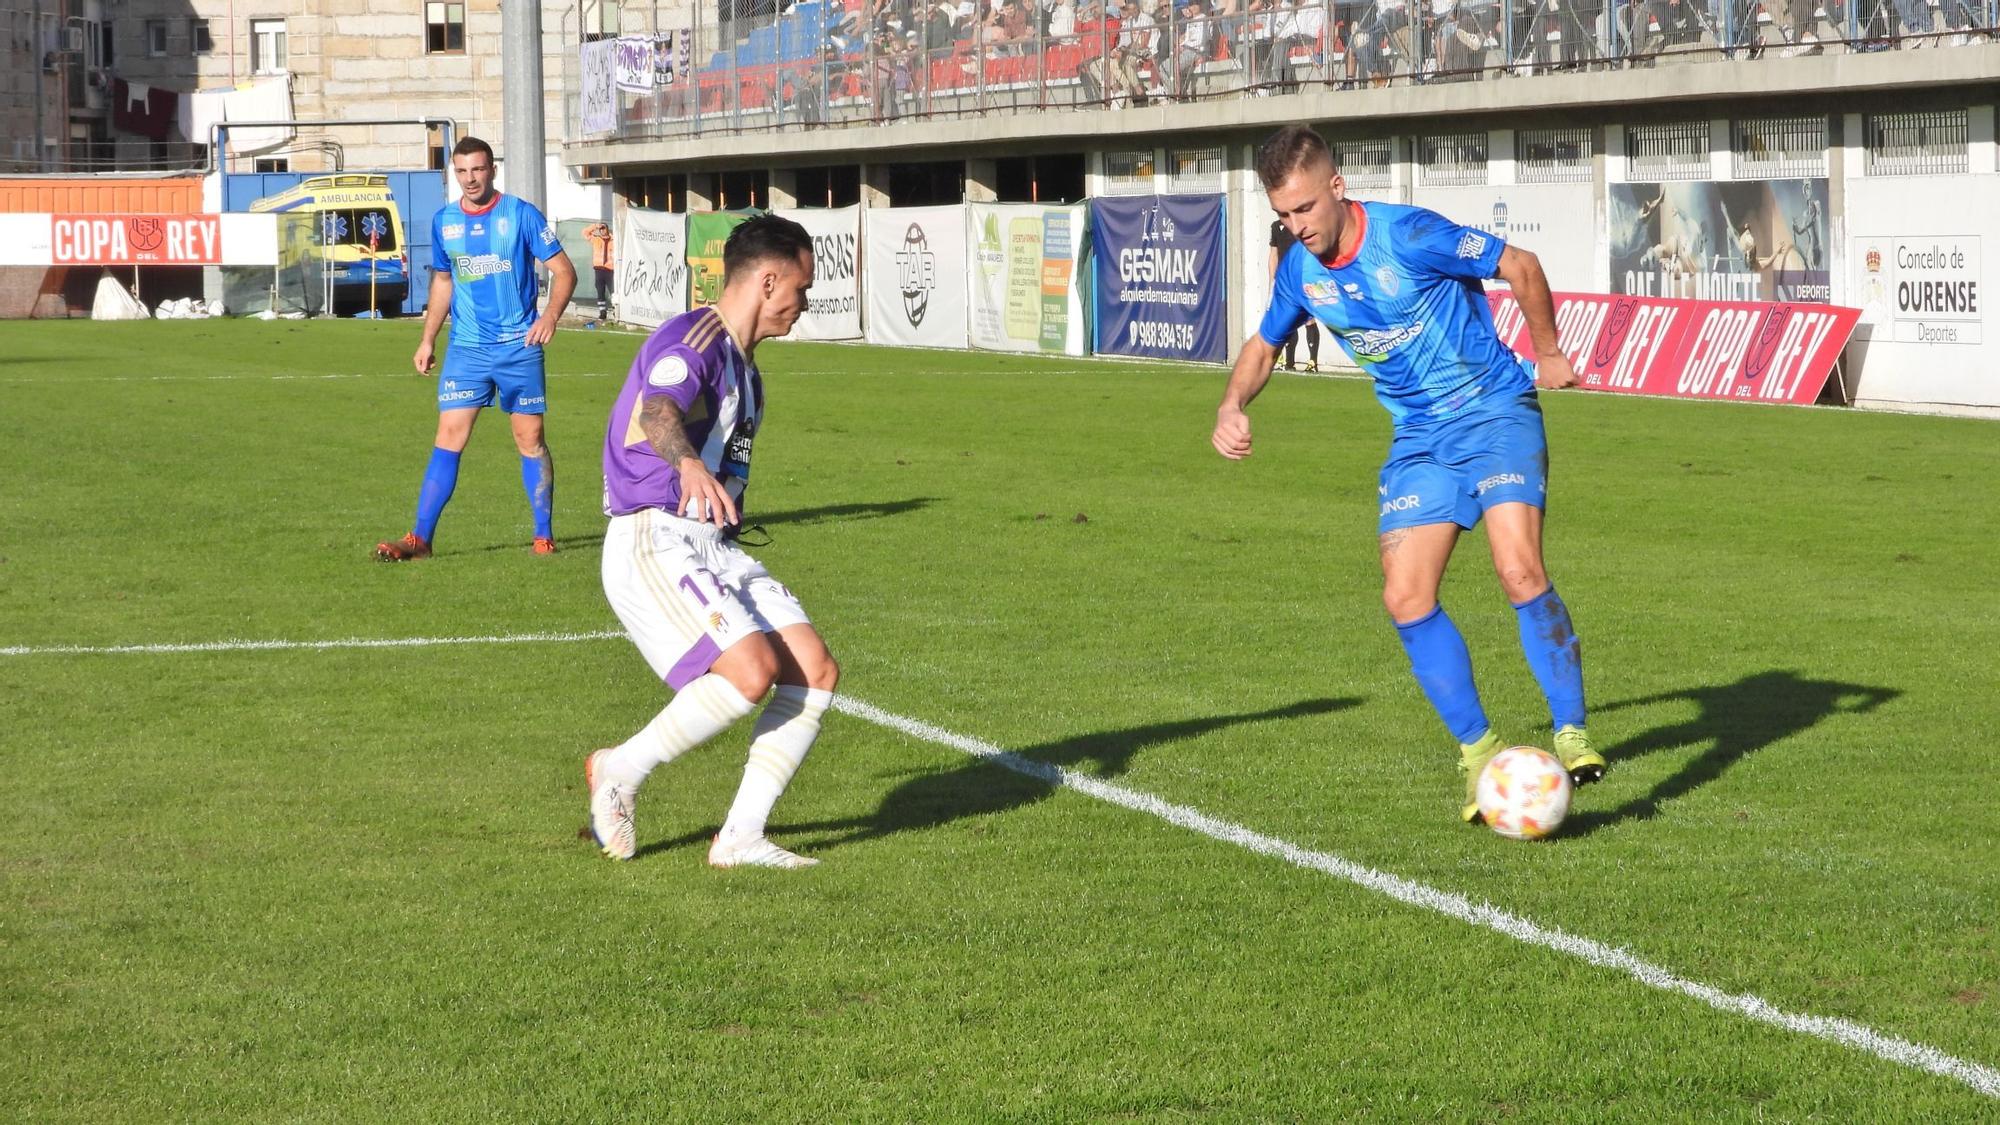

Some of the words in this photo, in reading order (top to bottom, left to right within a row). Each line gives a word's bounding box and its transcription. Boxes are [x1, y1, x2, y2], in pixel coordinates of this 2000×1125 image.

[321, 194, 382, 203] AMBULANCIA
[55, 219, 128, 261] COPA
[167, 219, 217, 261] REY
[457, 256, 511, 276] Ramos
[812, 233, 854, 281] RSAN
[896, 252, 935, 289] TAR
[1120, 248, 1197, 284] GESMAK
[1898, 245, 1947, 269] Concello
[1950, 245, 1964, 269] de
[1796, 285, 1830, 299] DEPORTE
[1898, 281, 1977, 312] OURENSE
[1139, 321, 1156, 347] 988
[1157, 323, 1175, 348] 384
[1608, 305, 1679, 389] REY
[1918, 323, 1957, 345] Deportes
[1677, 308, 1761, 396] COPA
[1758, 312, 1837, 400] REY
[1586, 373, 1602, 385] DEL
[1735, 385, 1752, 397] DEL
